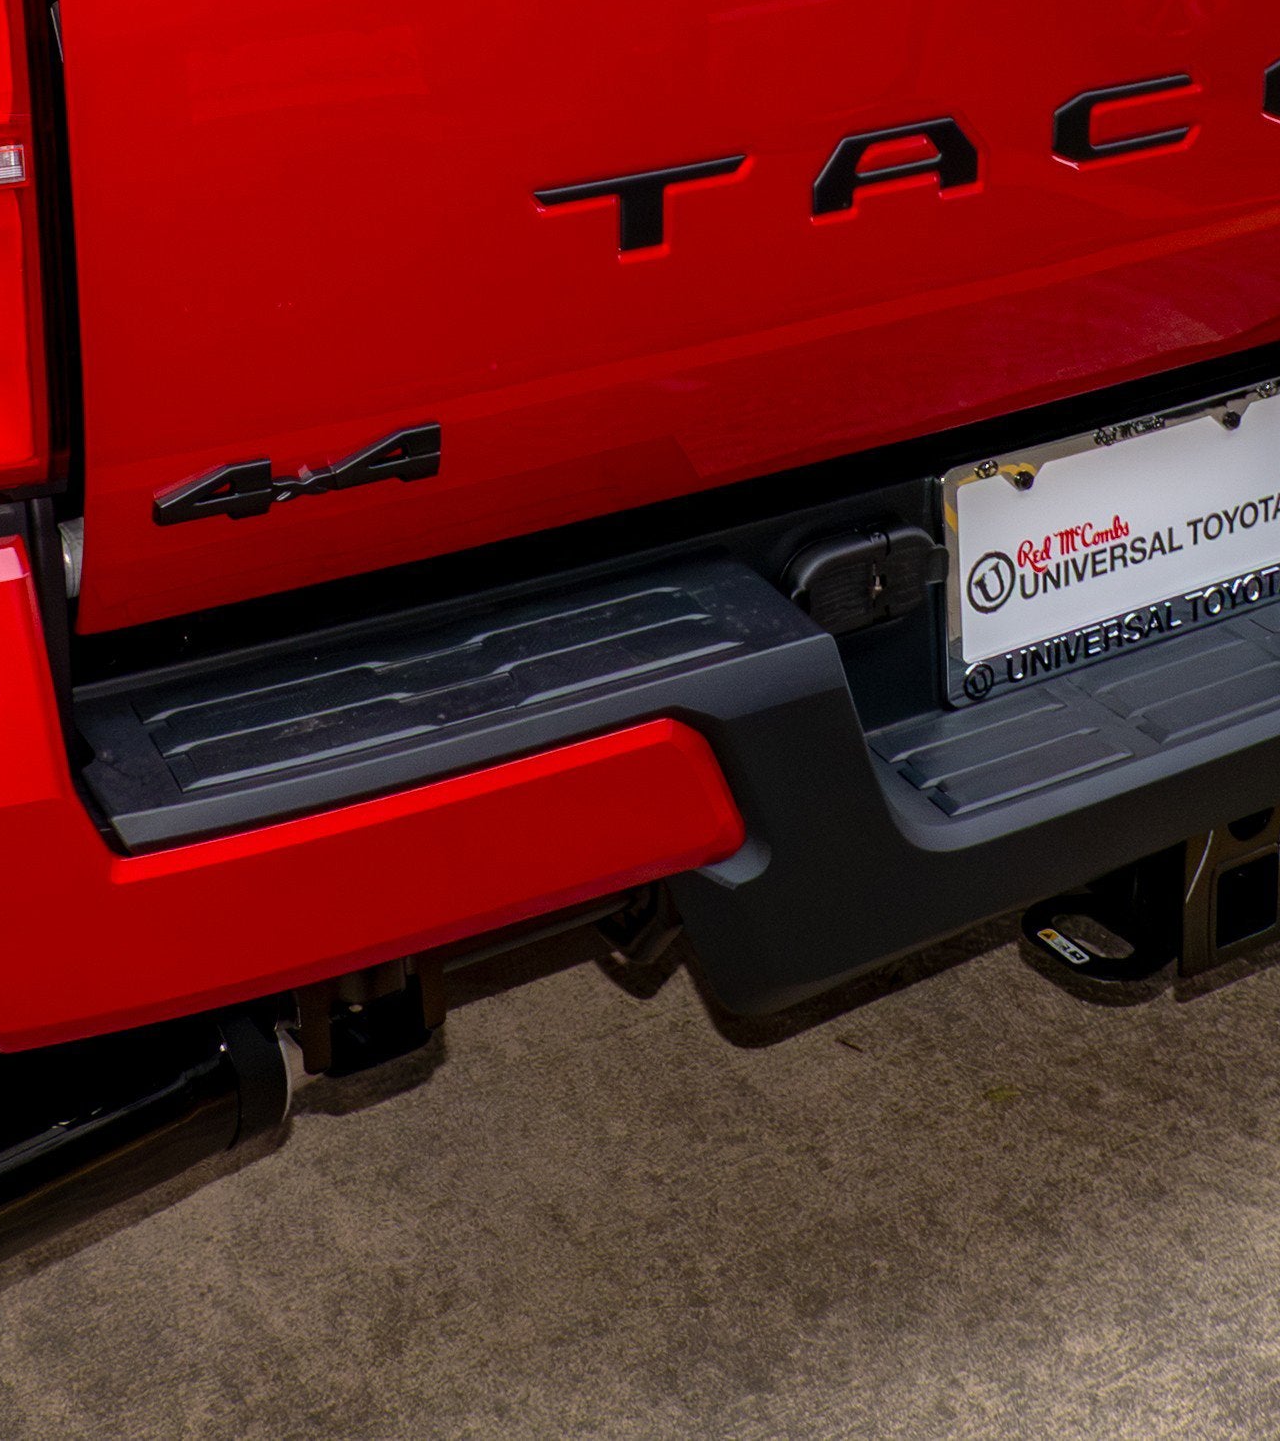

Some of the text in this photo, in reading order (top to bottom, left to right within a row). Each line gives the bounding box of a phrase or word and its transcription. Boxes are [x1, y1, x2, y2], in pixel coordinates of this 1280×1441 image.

[1017, 515, 1129, 573] Red McCombs
[1019, 526, 1184, 600] UNIVERSAL
[1006, 601, 1182, 684] UNIVERSAL
